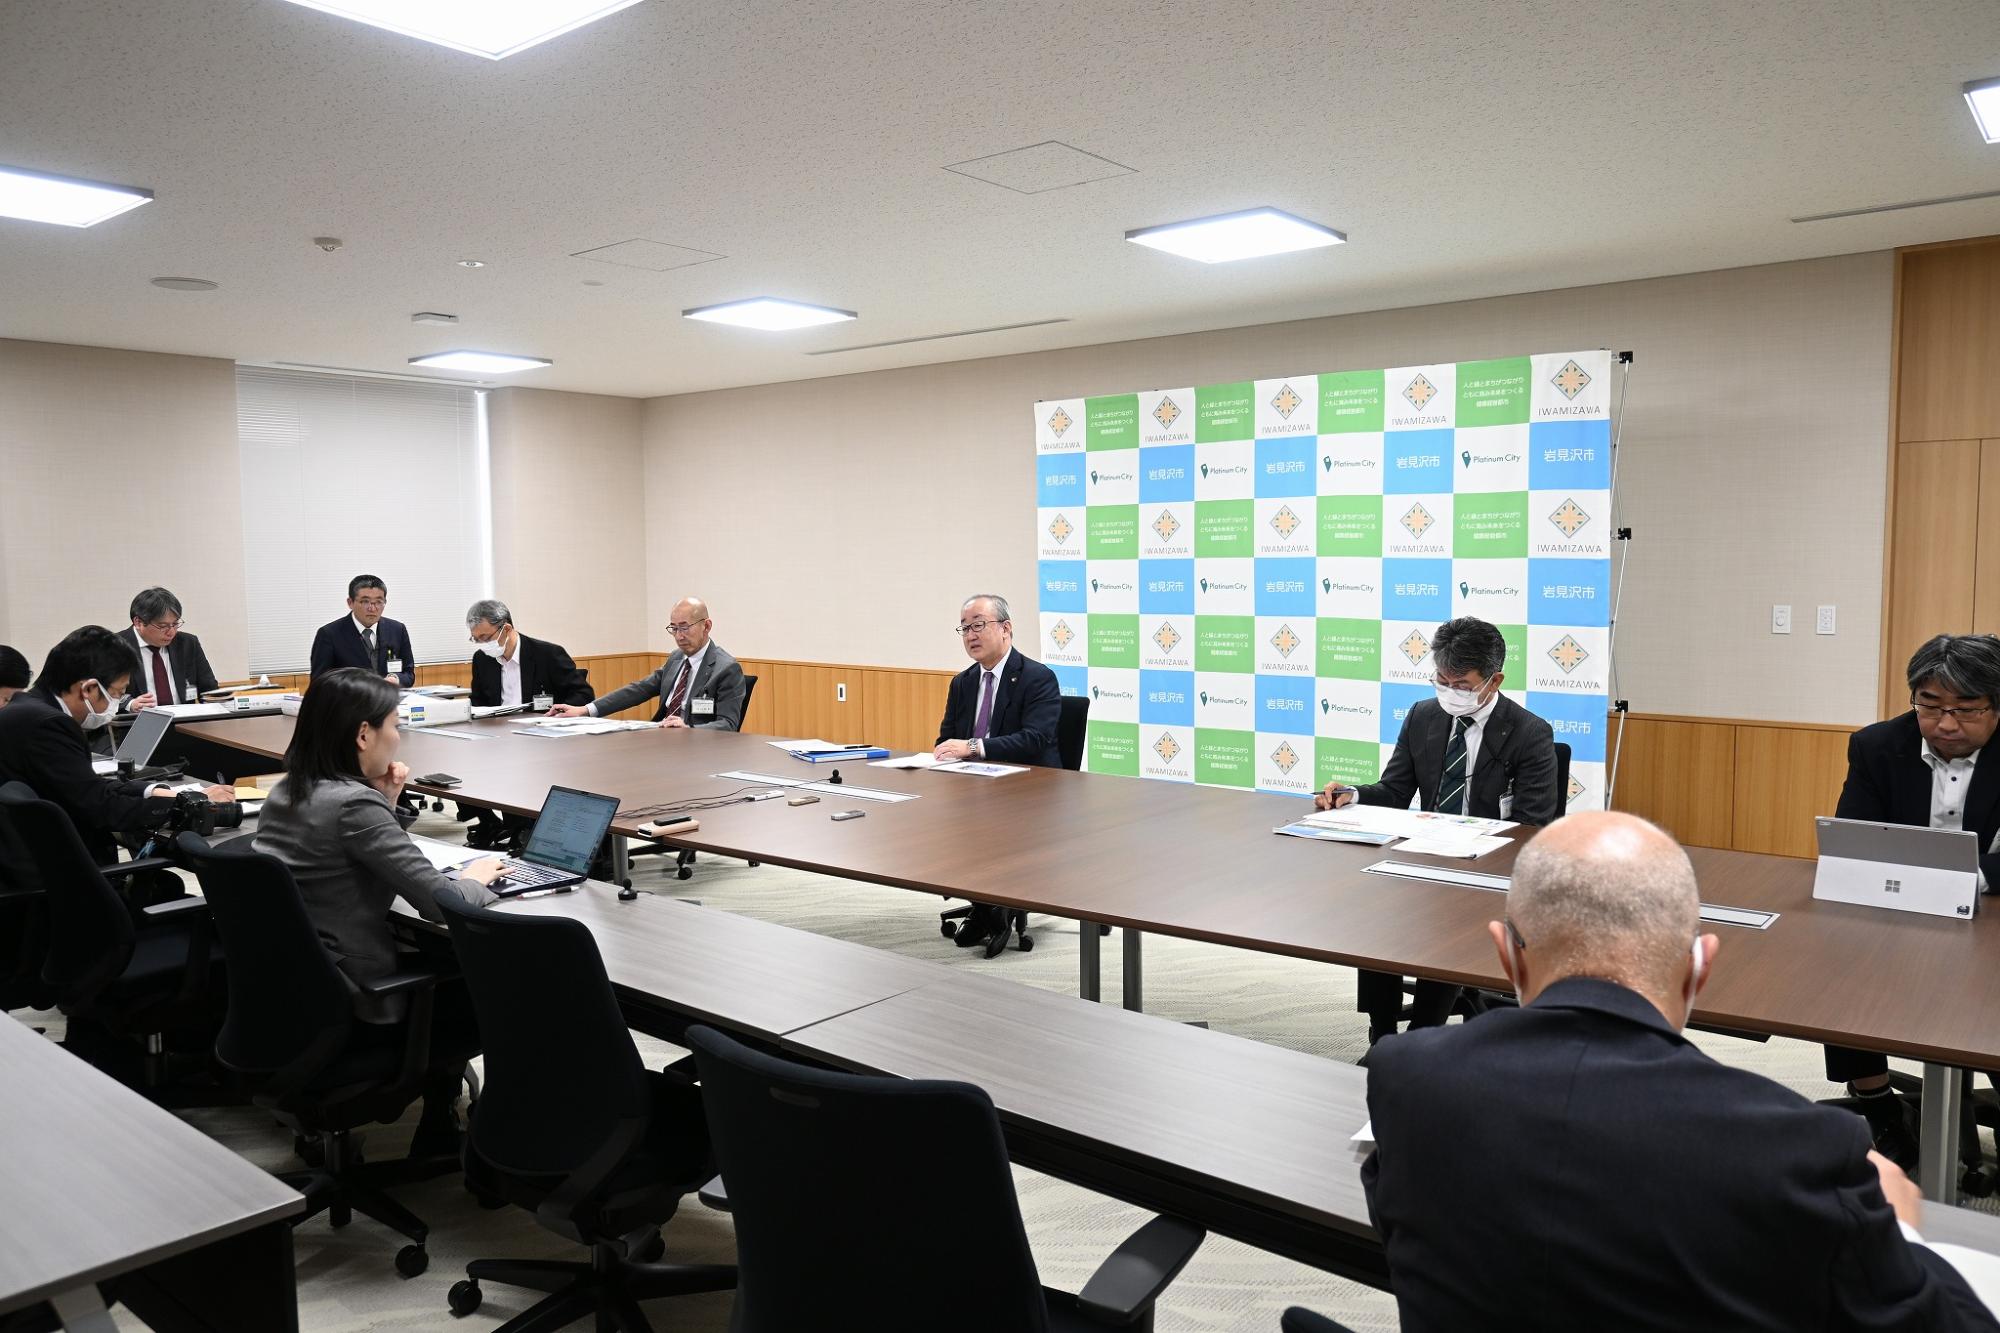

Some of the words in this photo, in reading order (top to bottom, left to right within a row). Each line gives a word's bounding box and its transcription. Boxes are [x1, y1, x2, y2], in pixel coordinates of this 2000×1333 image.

[1538, 405, 1601, 416] IWAMIZAWA
[1392, 416, 1447, 426] IWAMIZAWA
[1262, 424, 1311, 434] IWAMIZAWA
[1144, 433, 1189, 442] IWAMIZAWA
[1041, 442, 1081, 450] IWAMIZAWA
[1473, 454, 1504, 463] Platinum
[1505, 454, 1521, 463] City
[1544, 449, 1594, 462] 岩見沢市
[1334, 460, 1361, 468] Platinum
[1362, 460, 1375, 468] City
[1396, 456, 1440, 469] 岩見沢市
[1233, 465, 1247, 474] City
[1266, 462, 1305, 474] 岩見沢市
[1121, 472, 1133, 480] City
[1149, 468, 1184, 480] 岩見沢市
[1045, 475, 1076, 485] 岩見沢市
[1144, 546, 1188, 554] IWAMIZAWA
[1261, 545, 1309, 553] IWAMIZAWA
[1390, 544, 1445, 553] IWAMIZAWA
[1537, 543, 1601, 553] IWAMIZAWA
[1045, 581, 1077, 592] 岩見沢市
[1121, 583, 1133, 591] City
[1149, 582, 1184, 593] 岩見沢市
[1209, 582, 1232, 591] Platinum
[1233, 582, 1247, 591] City
[1266, 581, 1304, 593] 岩見沢市
[1332, 583, 1359, 591] Platinum
[1360, 584, 1374, 593] City
[1395, 583, 1439, 596] 岩見沢市
[1471, 587, 1501, 596] Platinum
[1503, 587, 1519, 597] City
[1543, 585, 1595, 599] 岩見沢市
[1045, 654, 1082, 662] IWAMIZAWA
[1145, 658, 1189, 666] IWAMIZAWA
[1262, 663, 1309, 672] IWAMIZAWA
[1388, 670, 1434, 680] IWAMIZA
[1535, 678, 1600, 689] IWAMIZAWA
[1122, 691, 1133, 699] City
[1149, 692, 1184, 703] 岩見沢市
[1209, 696, 1232, 704] Platinum
[1233, 697, 1247, 706] City
[1266, 699, 1304, 711] 岩見沢市
[1331, 705, 1357, 714] Platinum
[1359, 707, 1373, 716] City
[1552, 721, 1591, 734] 見沢市
[1146, 767, 1188, 777] IWAMIZAWA
[1263, 779, 1308, 789] IWAMIZAWA
